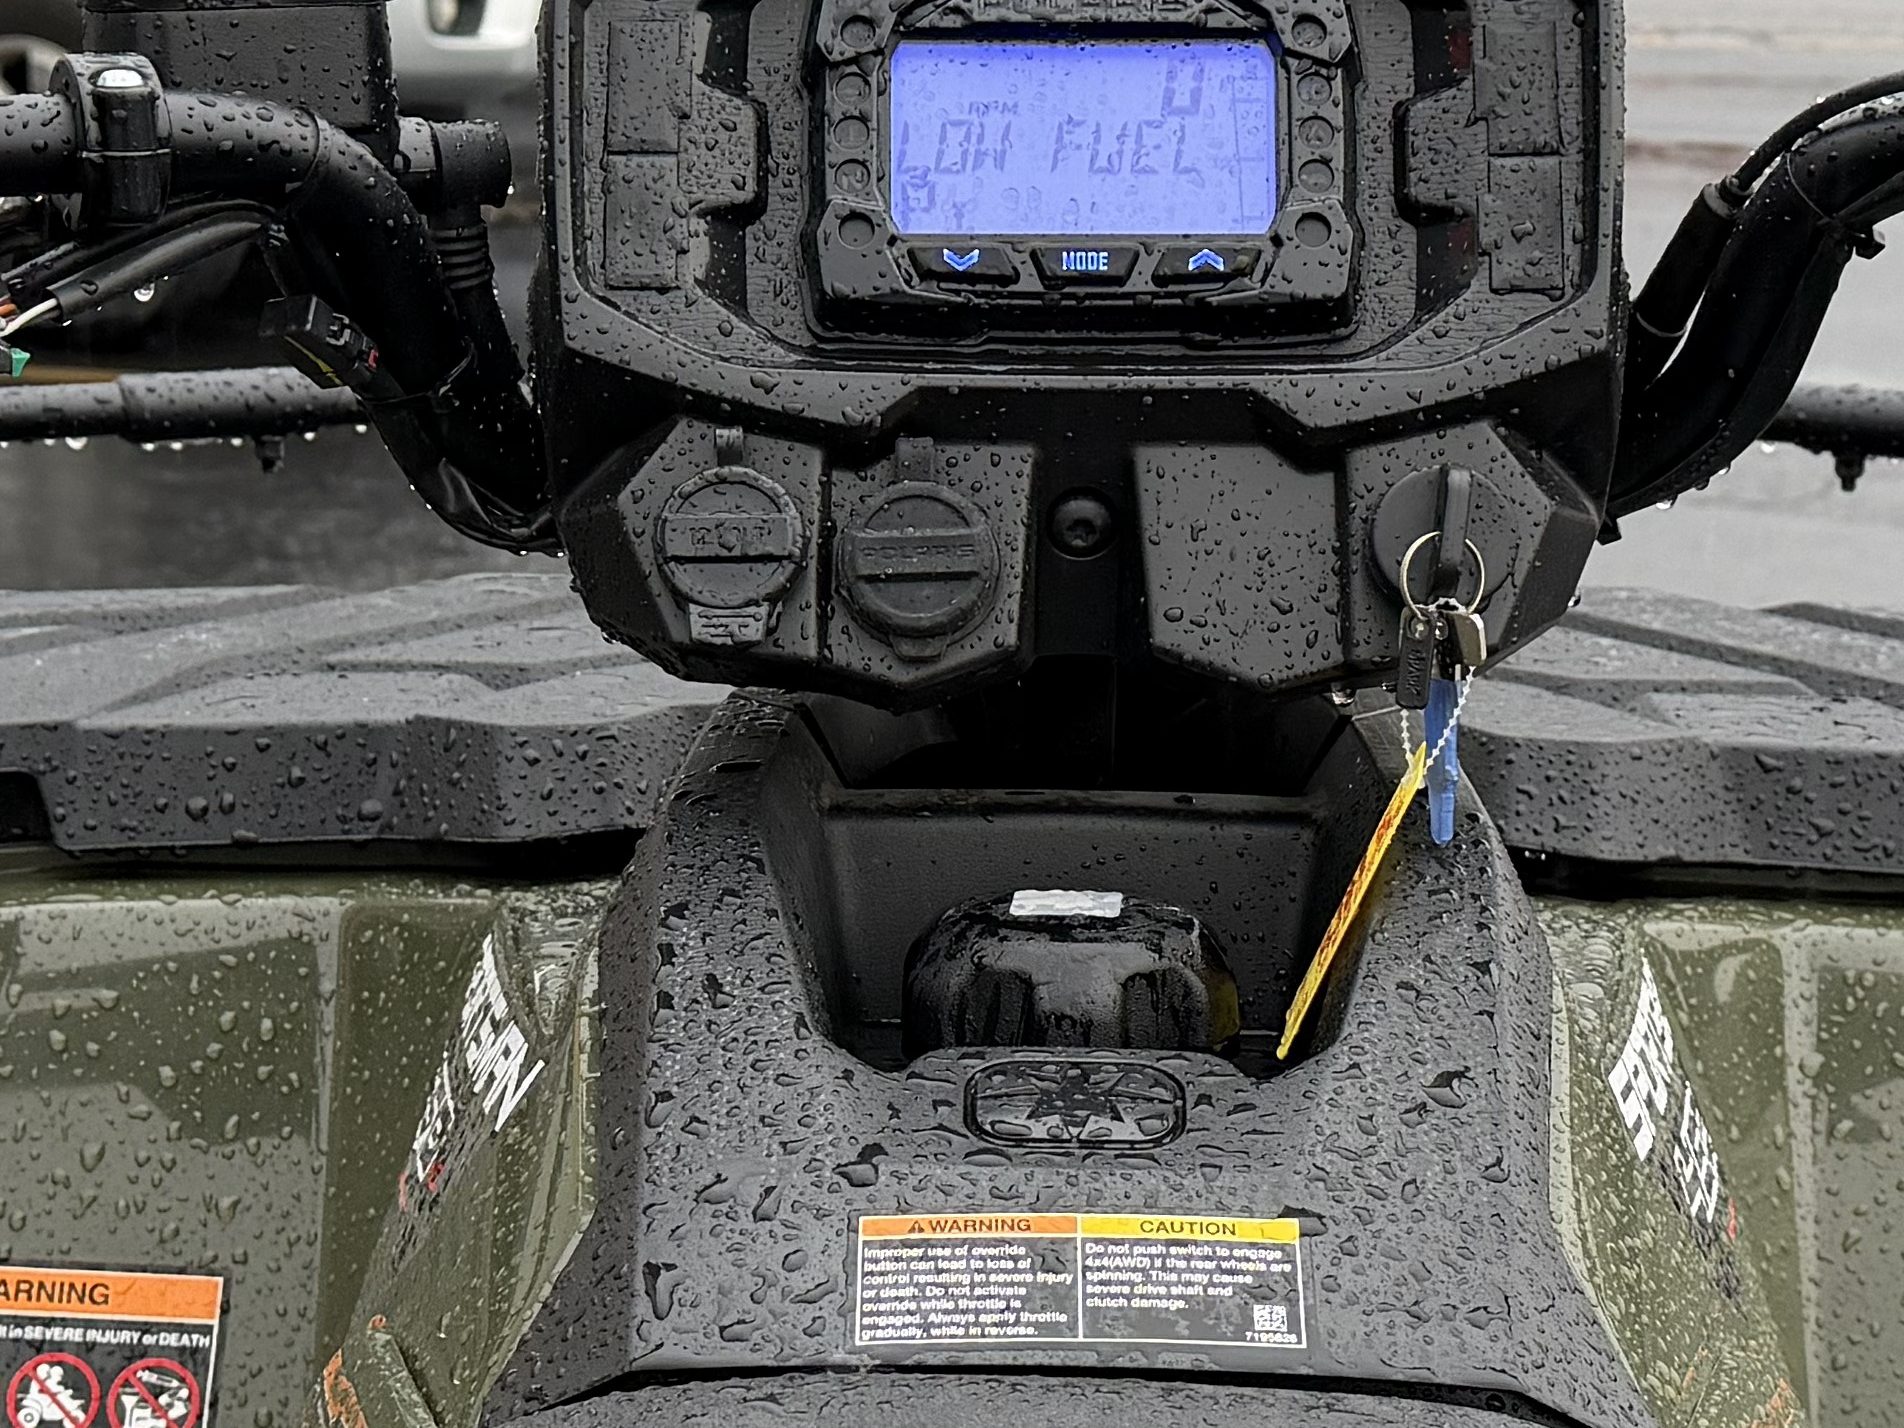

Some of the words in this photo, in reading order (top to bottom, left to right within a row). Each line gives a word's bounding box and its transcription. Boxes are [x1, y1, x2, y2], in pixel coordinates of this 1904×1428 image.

[897, 119, 1013, 174] LOW
[1050, 118, 1198, 174] FUEL
[1061, 250, 1109, 271] MODE
[929, 1217, 1030, 1232] WARNING
[1140, 1220, 1236, 1235] CAUTION
[863, 1246, 925, 1259] Improper
[927, 1248, 952, 1256] use
[954, 1246, 969, 1256] of
[972, 1245, 1026, 1256] override
[1085, 1243, 1106, 1255] Do
[1108, 1243, 1130, 1256] not
[1132, 1243, 1168, 1259] push
[1169, 1243, 1212, 1256] switch
[1214, 1244, 1229, 1256] to
[1231, 1247, 1282, 1260] engage
[863, 1258, 906, 1271] button
[908, 1261, 935, 1271] can
[937, 1258, 965, 1271] lead
[968, 1258, 984, 1271] to
[986, 1258, 1014, 1271] loss
[1016, 1258, 1031, 1271] of
[1153, 1256, 1163, 1268] if
[1164, 1256, 1187, 1268] the
[1189, 1259, 1218, 1268] rear
[1220, 1257, 1265, 1269] wheels
[1267, 1260, 1291, 1269] are
[863, 1271, 909, 1282] control
[911, 1271, 971, 1285] resulting
[973, 1271, 985, 1282] in
[987, 1274, 1034, 1282] severe
[1036, 1271, 1073, 1285] injury
[1085, 1270, 1146, 1284] spinning.
[1147, 1270, 1179, 1281] This
[1181, 1273, 1210, 1284] may
[1212, 1273, 1253, 1282] cause
[1086, 1286, 1131, 1295] severe
[1133, 1284, 1167, 1295] drive
[1169, 1284, 1204, 1296] shaft
[1206, 1284, 1232, 1296] and
[1086, 1296, 1127, 1307] clutch
[1129, 1297, 1188, 1310] damage.
[8, 1325, 22, 1337] in
[23, 1326, 84, 1340] SEVERE
[85, 1329, 140, 1342] INJURY
[141, 1334, 157, 1343] or
[158, 1332, 209, 1346] DEATH
